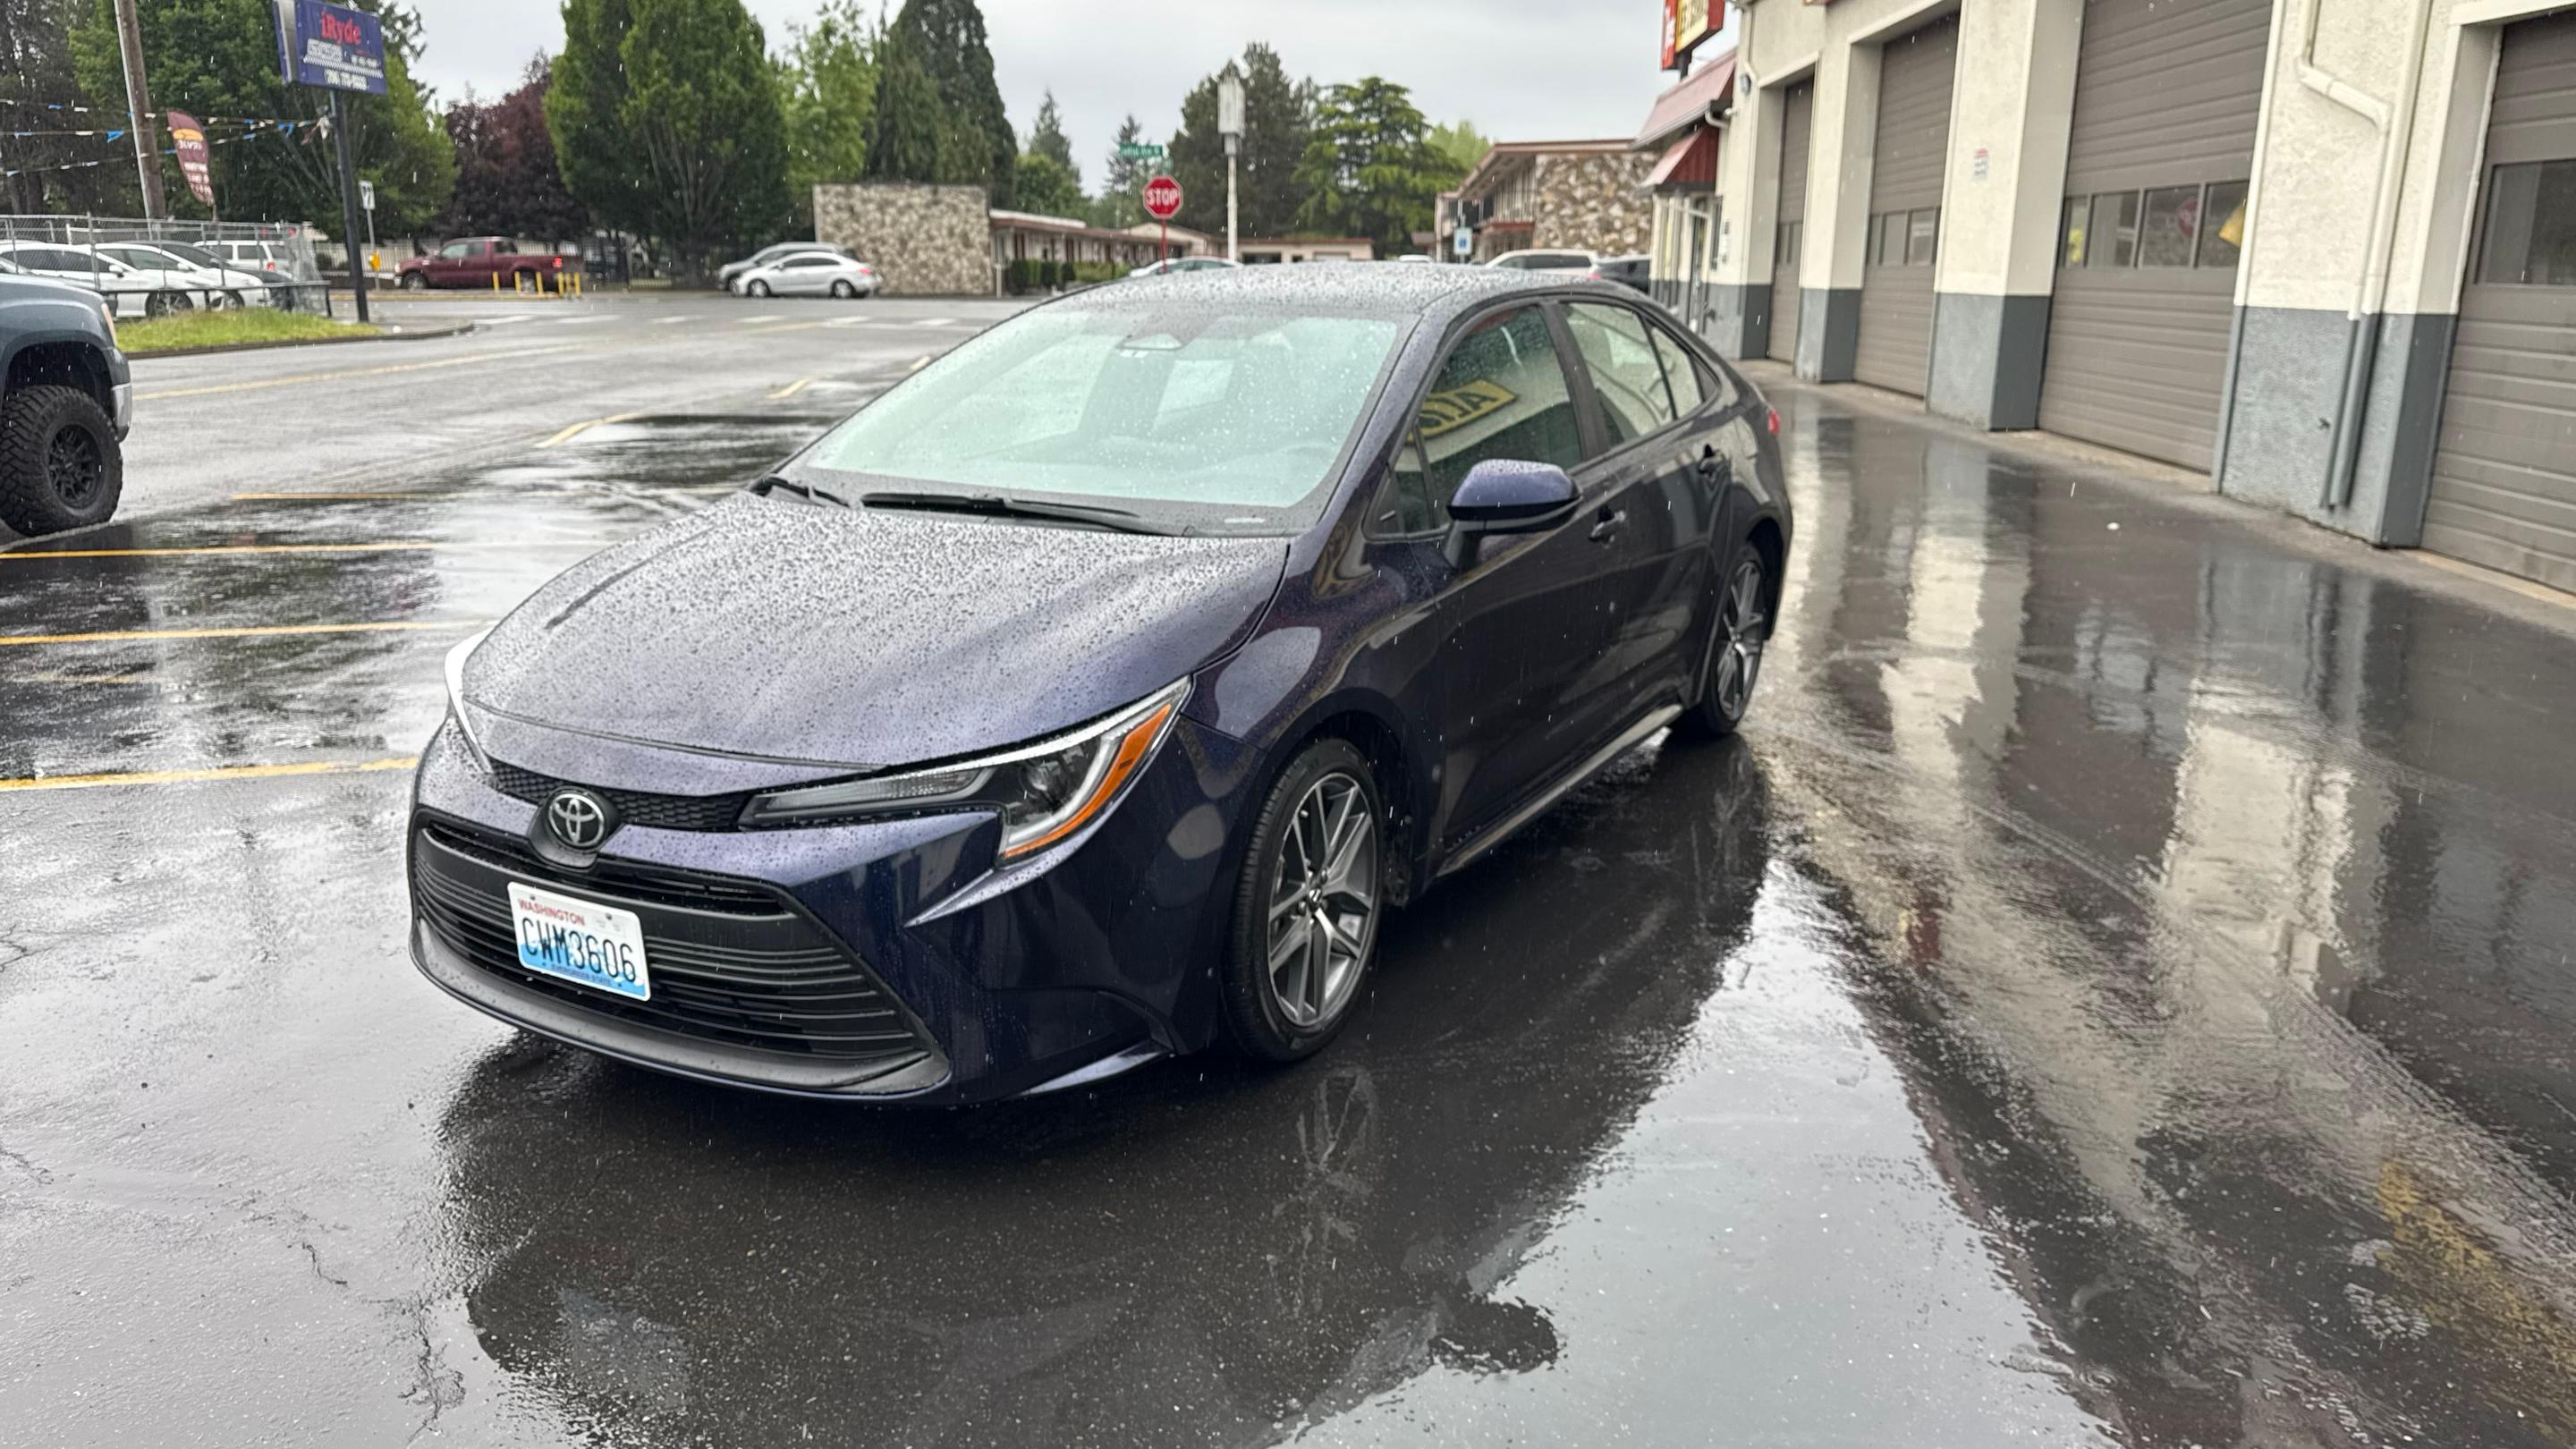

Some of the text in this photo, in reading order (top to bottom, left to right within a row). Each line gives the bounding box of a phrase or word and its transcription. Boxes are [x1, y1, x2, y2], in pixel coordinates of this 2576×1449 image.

[319, 8, 362, 45] iRyde
[1146, 188, 1179, 206] STOP
[518, 898, 585, 926] WASHINGTON
[522, 917, 636, 983] CWM3606
